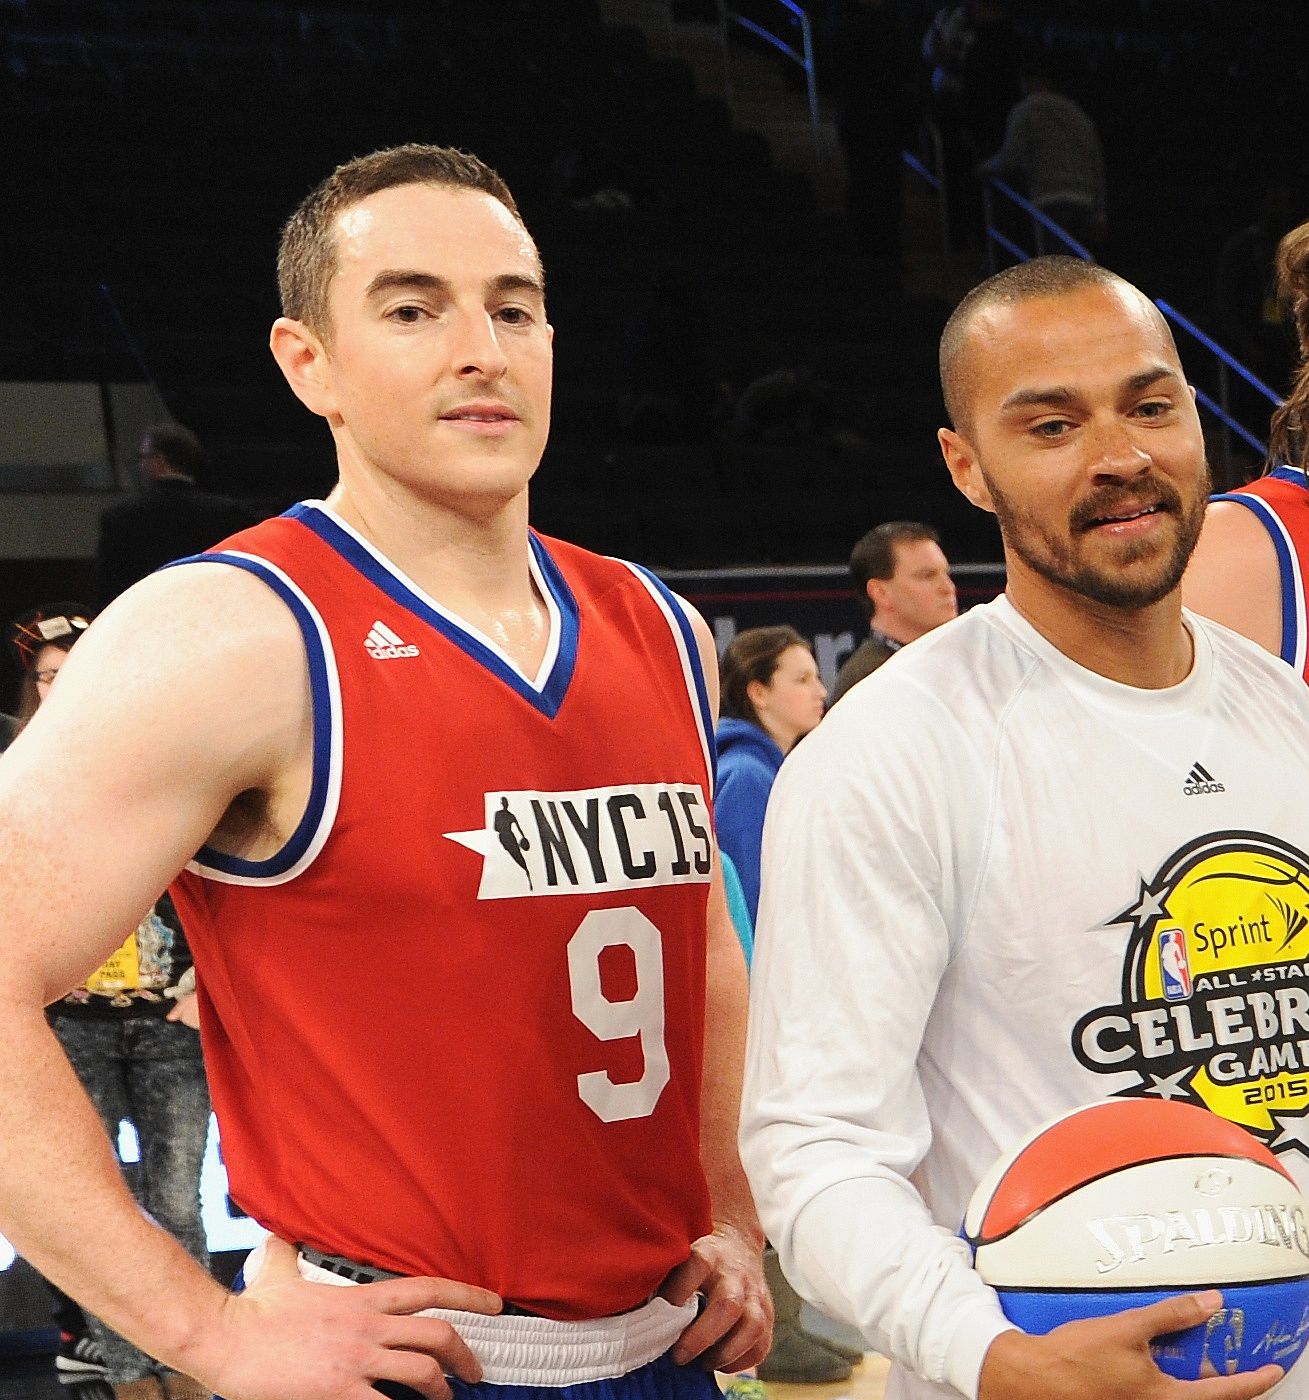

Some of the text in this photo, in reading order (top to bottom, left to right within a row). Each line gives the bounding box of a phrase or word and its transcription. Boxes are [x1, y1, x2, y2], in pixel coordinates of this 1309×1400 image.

[366, 645, 420, 660] didas
[1183, 780, 1226, 796] adidas
[529, 791, 711, 887] NYC 15
[1193, 914, 1273, 959] Sprint
[1196, 973, 1249, 993] ALL
[566, 905, 671, 1123] 9
[1242, 1078, 1309, 1106] 2015
